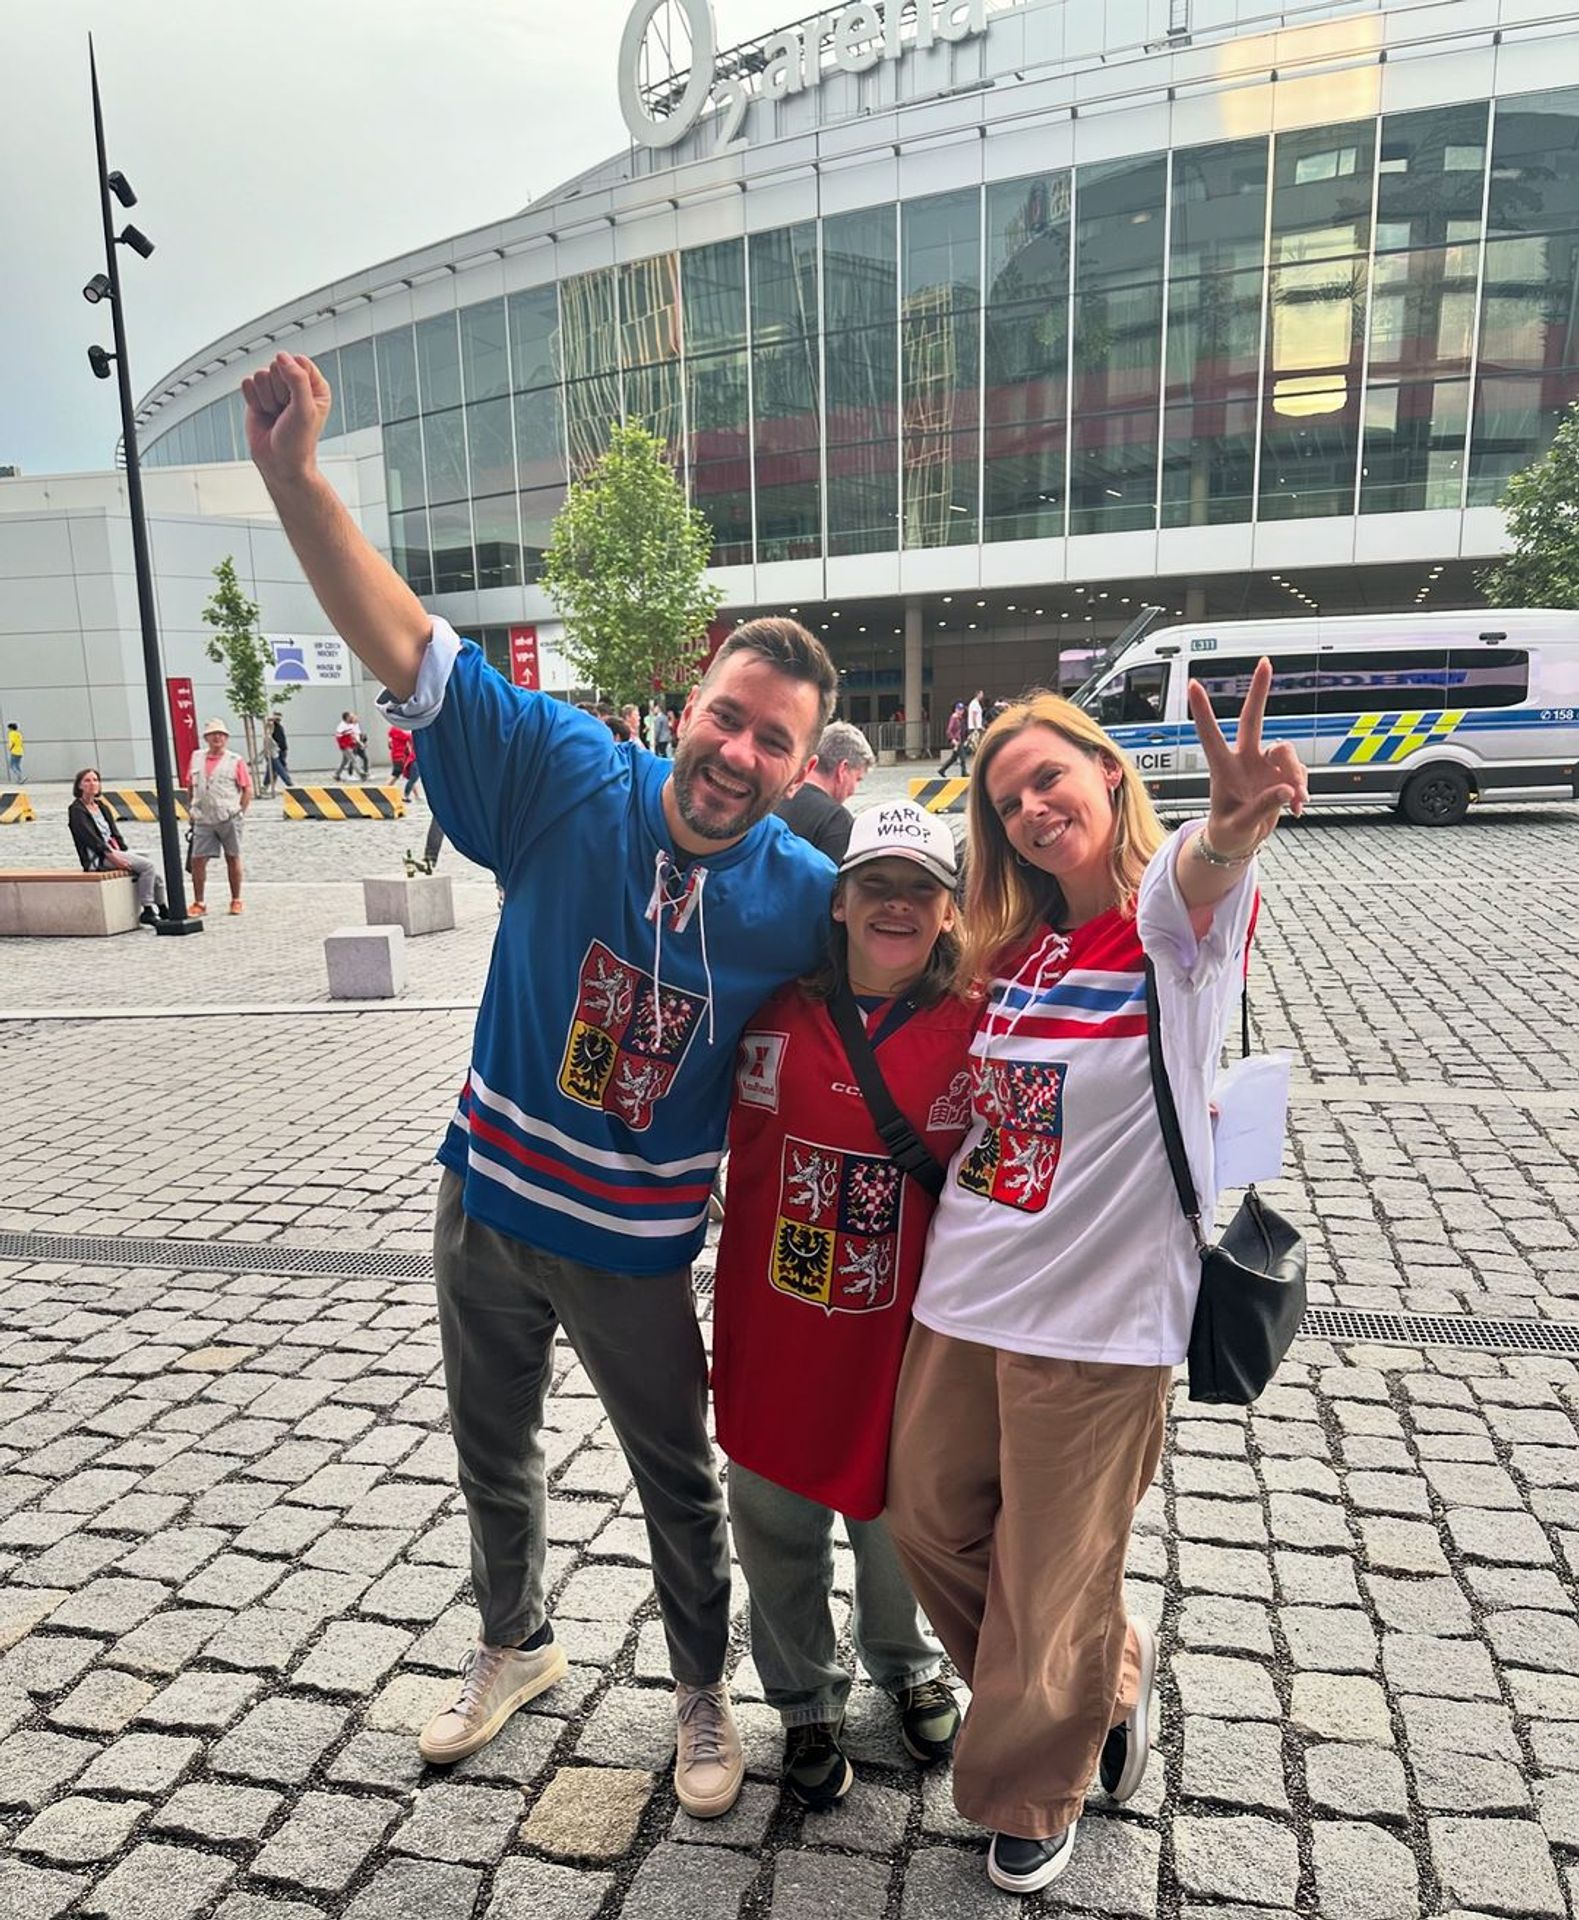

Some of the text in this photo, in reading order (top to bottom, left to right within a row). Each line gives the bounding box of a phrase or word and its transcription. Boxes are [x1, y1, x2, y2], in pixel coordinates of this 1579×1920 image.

[761, 0, 990, 101] arena
[1553, 710, 1573, 720] 158
[1136, 753, 1171, 769] ICIE
[880, 808, 920, 822] KARL
[877, 824, 931, 843] WHO?
[831, 1082, 863, 1097] CC
